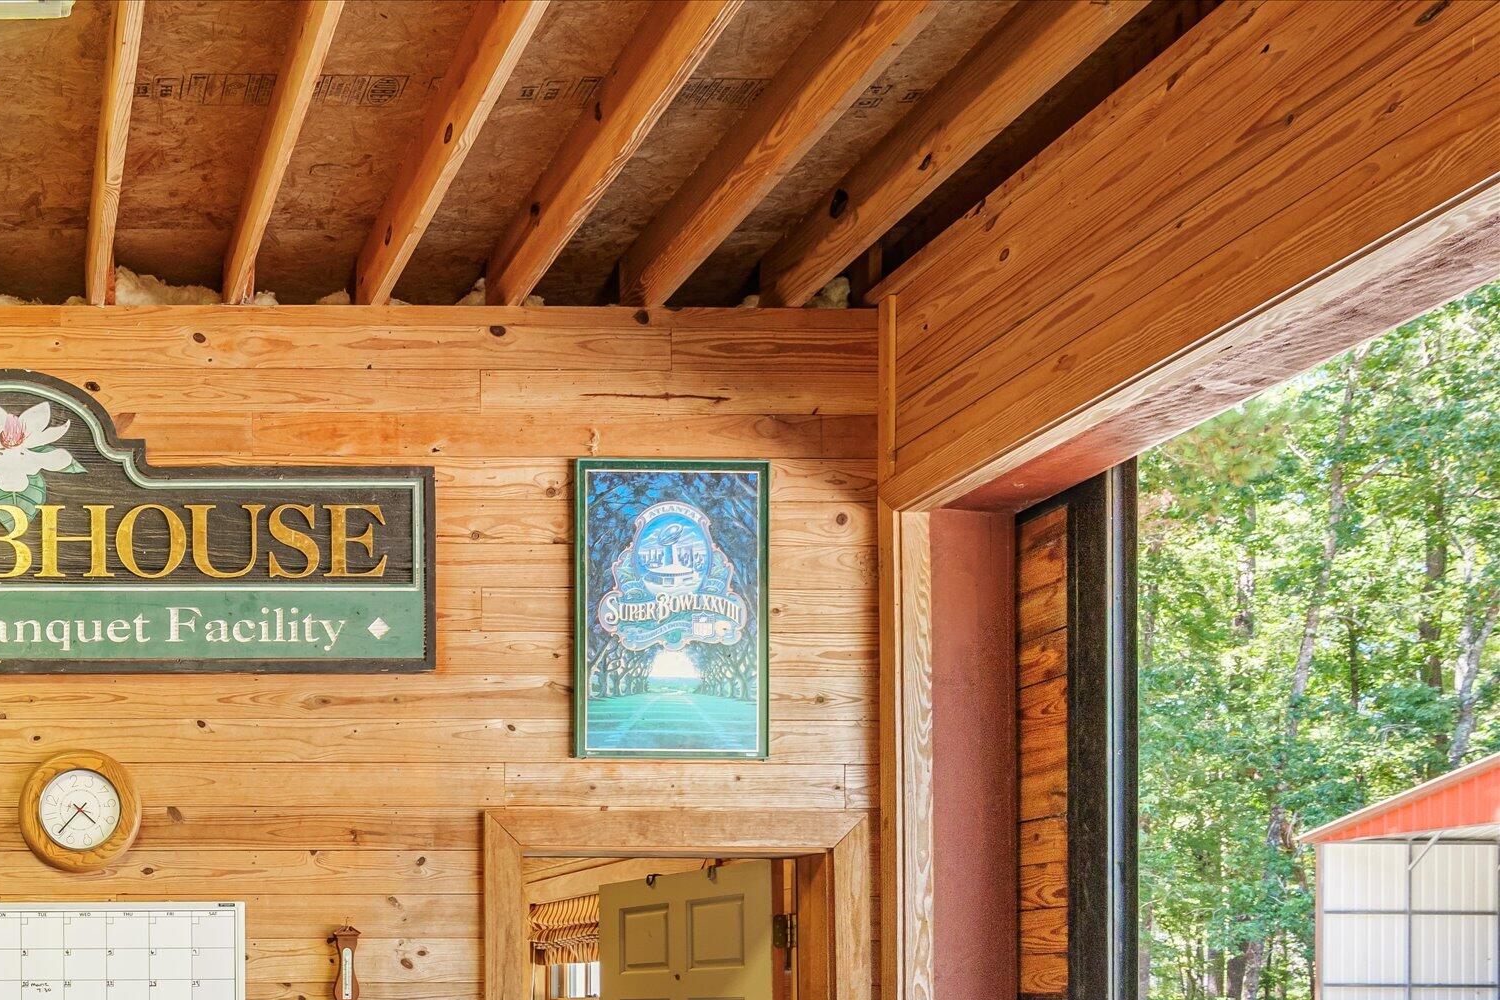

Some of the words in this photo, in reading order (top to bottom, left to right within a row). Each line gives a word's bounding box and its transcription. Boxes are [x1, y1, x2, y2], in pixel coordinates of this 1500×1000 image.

[648, 505, 697, 518] ATLANTA
[604, 596, 657, 625] SUPER
[655, 592, 701, 624] BOWL
[700, 594, 741, 625] XXVIII
[164, 606, 346, 652] Facility
[69, 774, 79, 788] 2
[84, 775, 94, 788] 3
[97, 785, 109, 794] 4
[45, 794, 60, 807] 12
[103, 798, 116, 808] 5
[103, 815, 116, 825] 6
[65, 832, 75, 844] 9
[82, 833, 93, 846] 8
